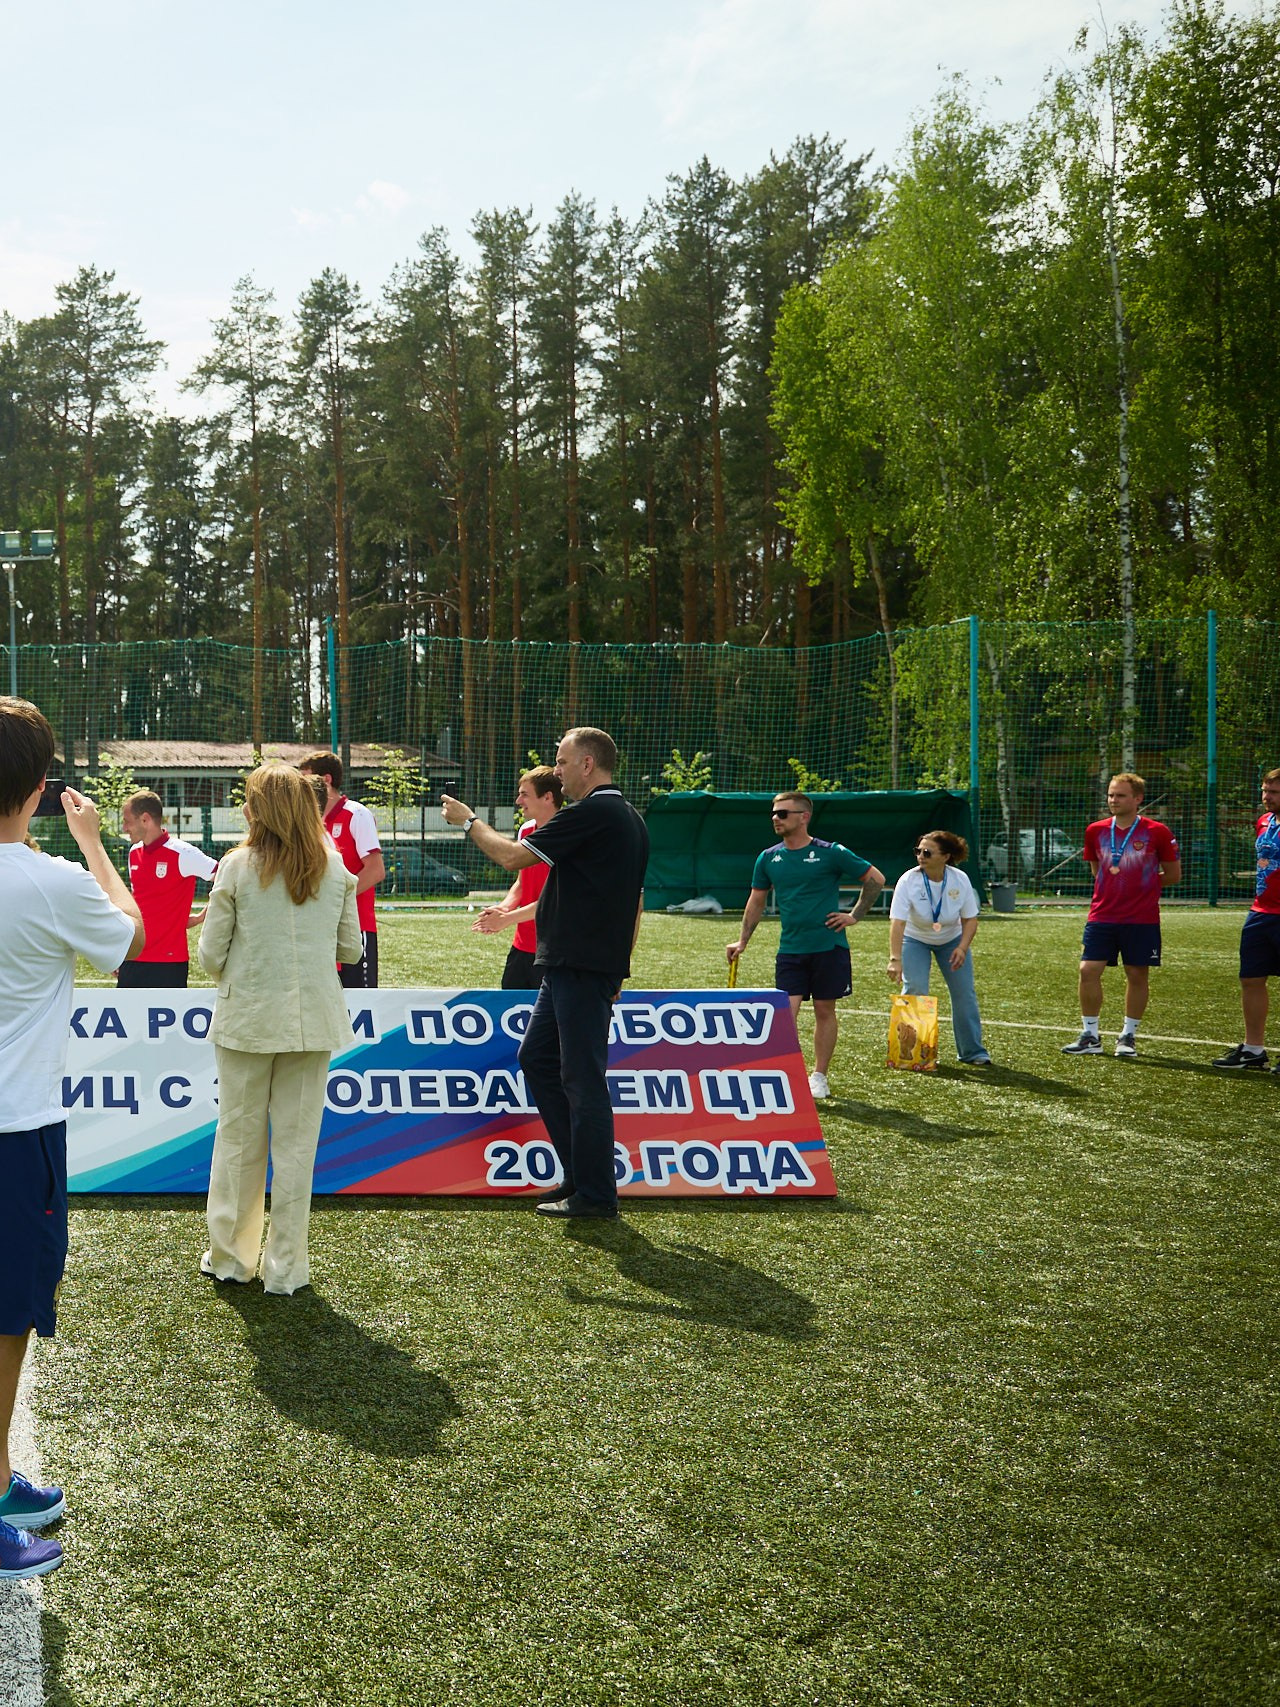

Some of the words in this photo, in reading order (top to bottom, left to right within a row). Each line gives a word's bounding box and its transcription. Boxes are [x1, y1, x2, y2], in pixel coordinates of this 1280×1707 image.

[411, 1009, 487, 1039] ПО
[508, 1008, 768, 1039] ФБОЛУ
[62, 1076, 139, 1115] ИЦ
[159, 1075, 192, 1108] С
[214, 1075, 687, 1108] ОЛЕВАЕМ
[706, 1075, 788, 1115] ЦП
[646, 1146, 808, 1188] ГОДА
